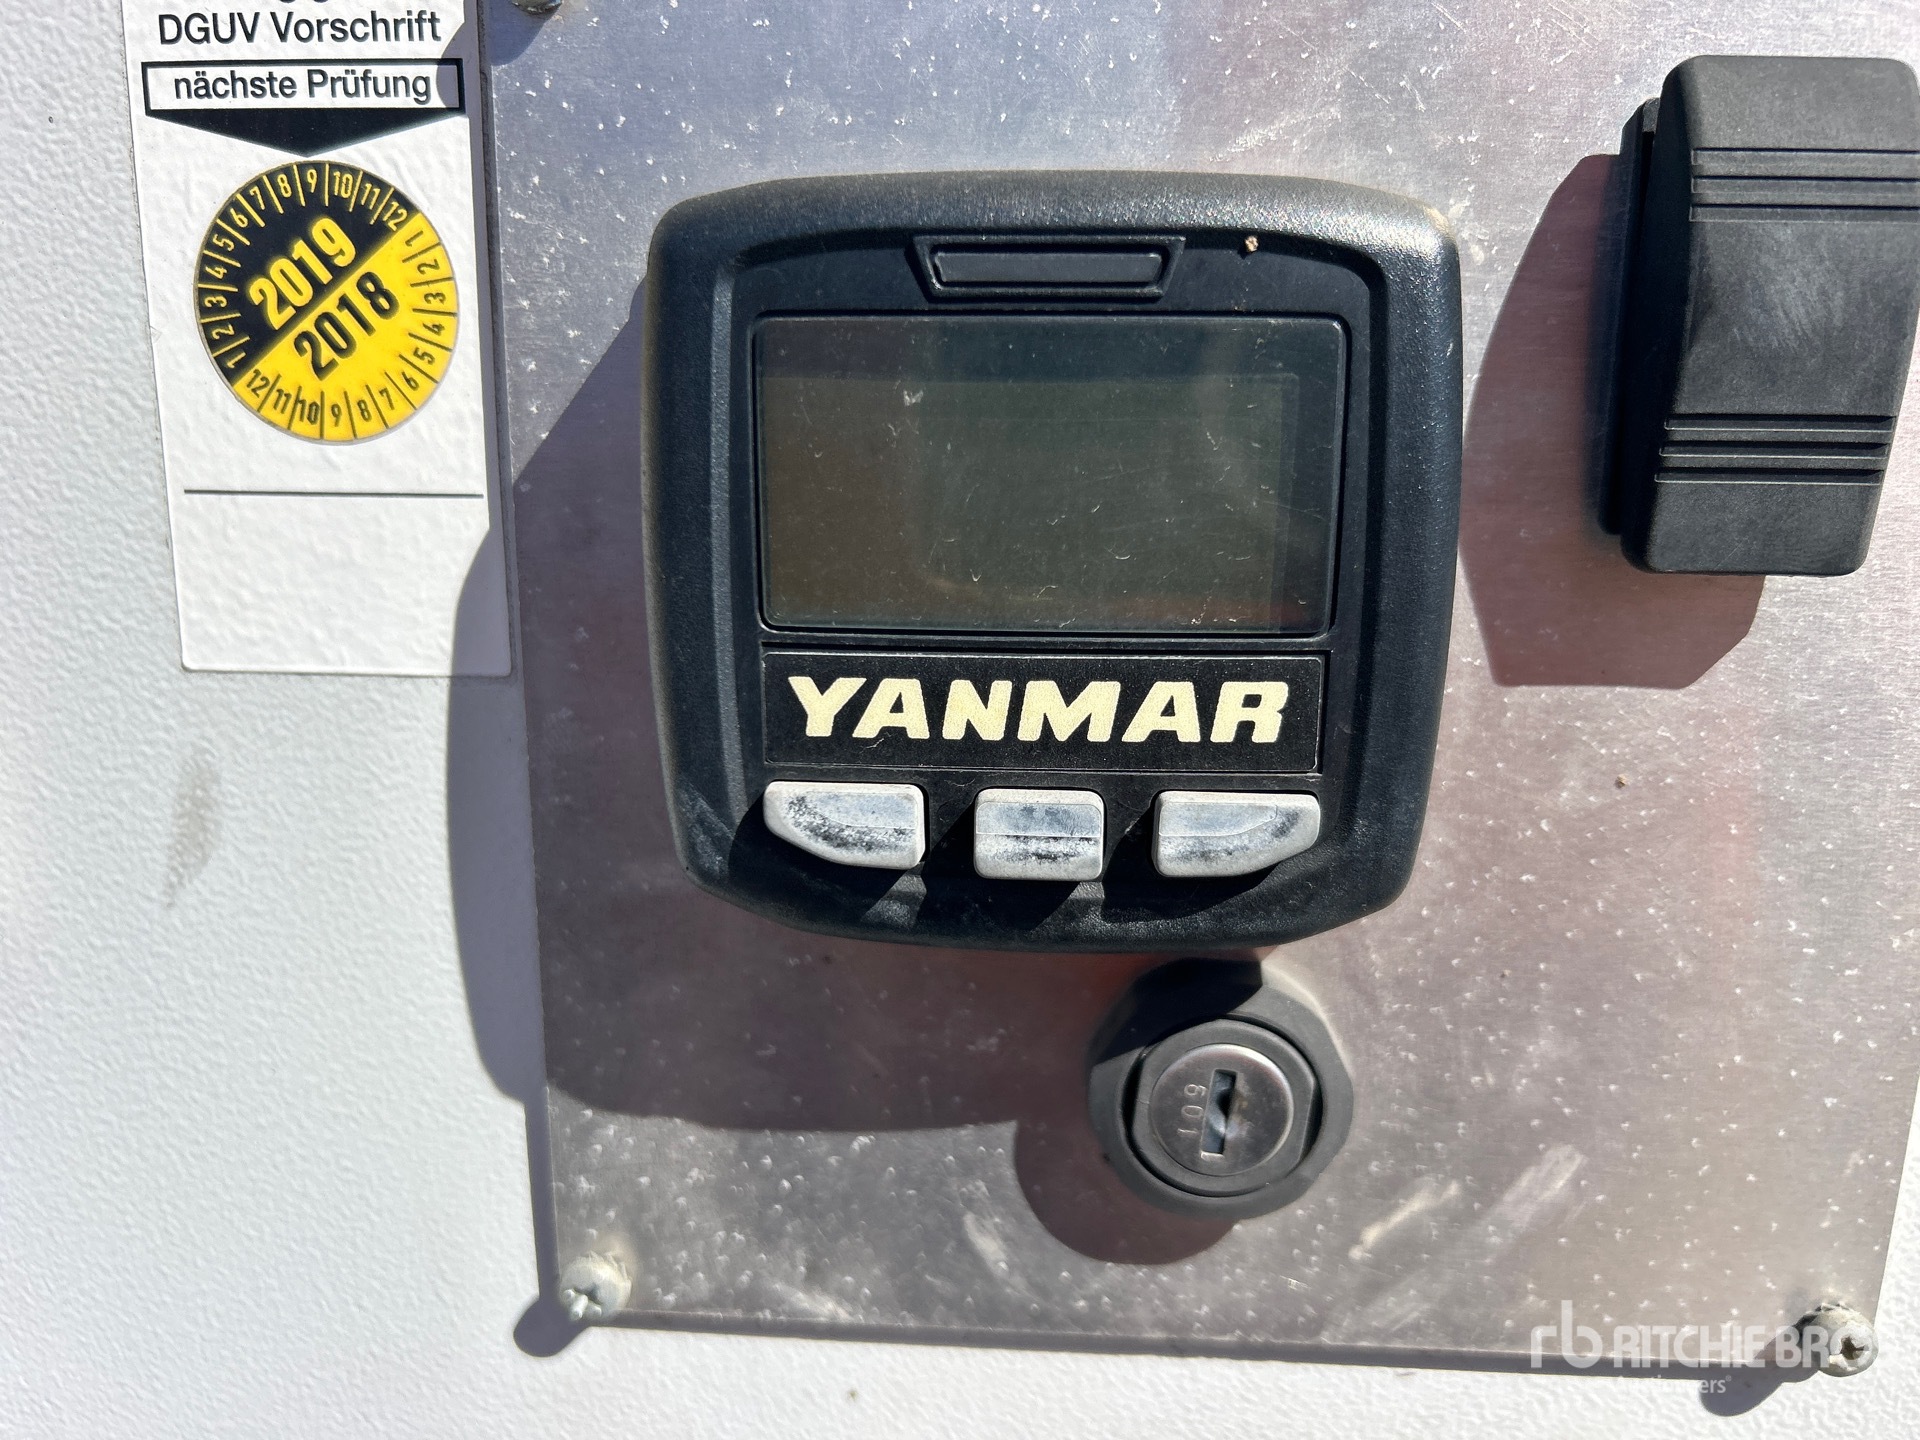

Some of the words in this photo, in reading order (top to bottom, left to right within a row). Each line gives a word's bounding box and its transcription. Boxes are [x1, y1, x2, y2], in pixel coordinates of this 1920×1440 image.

[159, 11, 260, 45] DGUV
[270, 10, 442, 43] Vorschrift
[174, 70, 298, 100] nächste
[307, 69, 432, 105] Prüfung
[277, 174, 292, 197] 8
[307, 169, 317, 193] 9
[333, 171, 353, 198] 10
[250, 187, 265, 210] 7
[361, 183, 381, 209] 11
[230, 208, 248, 228] 6
[382, 201, 408, 231] 12
[212, 235, 235, 251] 5
[405, 230, 424, 247] 1
[205, 266, 228, 279] 4
[249, 217, 356, 330] 2019
[417, 258, 440, 274] 2
[204, 292, 227, 307] 3
[424, 292, 446, 305] 3
[212, 322, 234, 340] 2
[294, 271, 400, 381] 2018
[422, 322, 445, 336] 4
[226, 352, 246, 368] 1
[414, 347, 435, 365] 5
[246, 368, 270, 397] 12
[401, 371, 419, 391] 6
[276, 387, 292, 414] 11
[357, 399, 372, 422] 8
[379, 388, 395, 410] 7
[298, 397, 321, 425] 10
[331, 404, 342, 427] 9
[788, 676, 1290, 743] YANMAR
